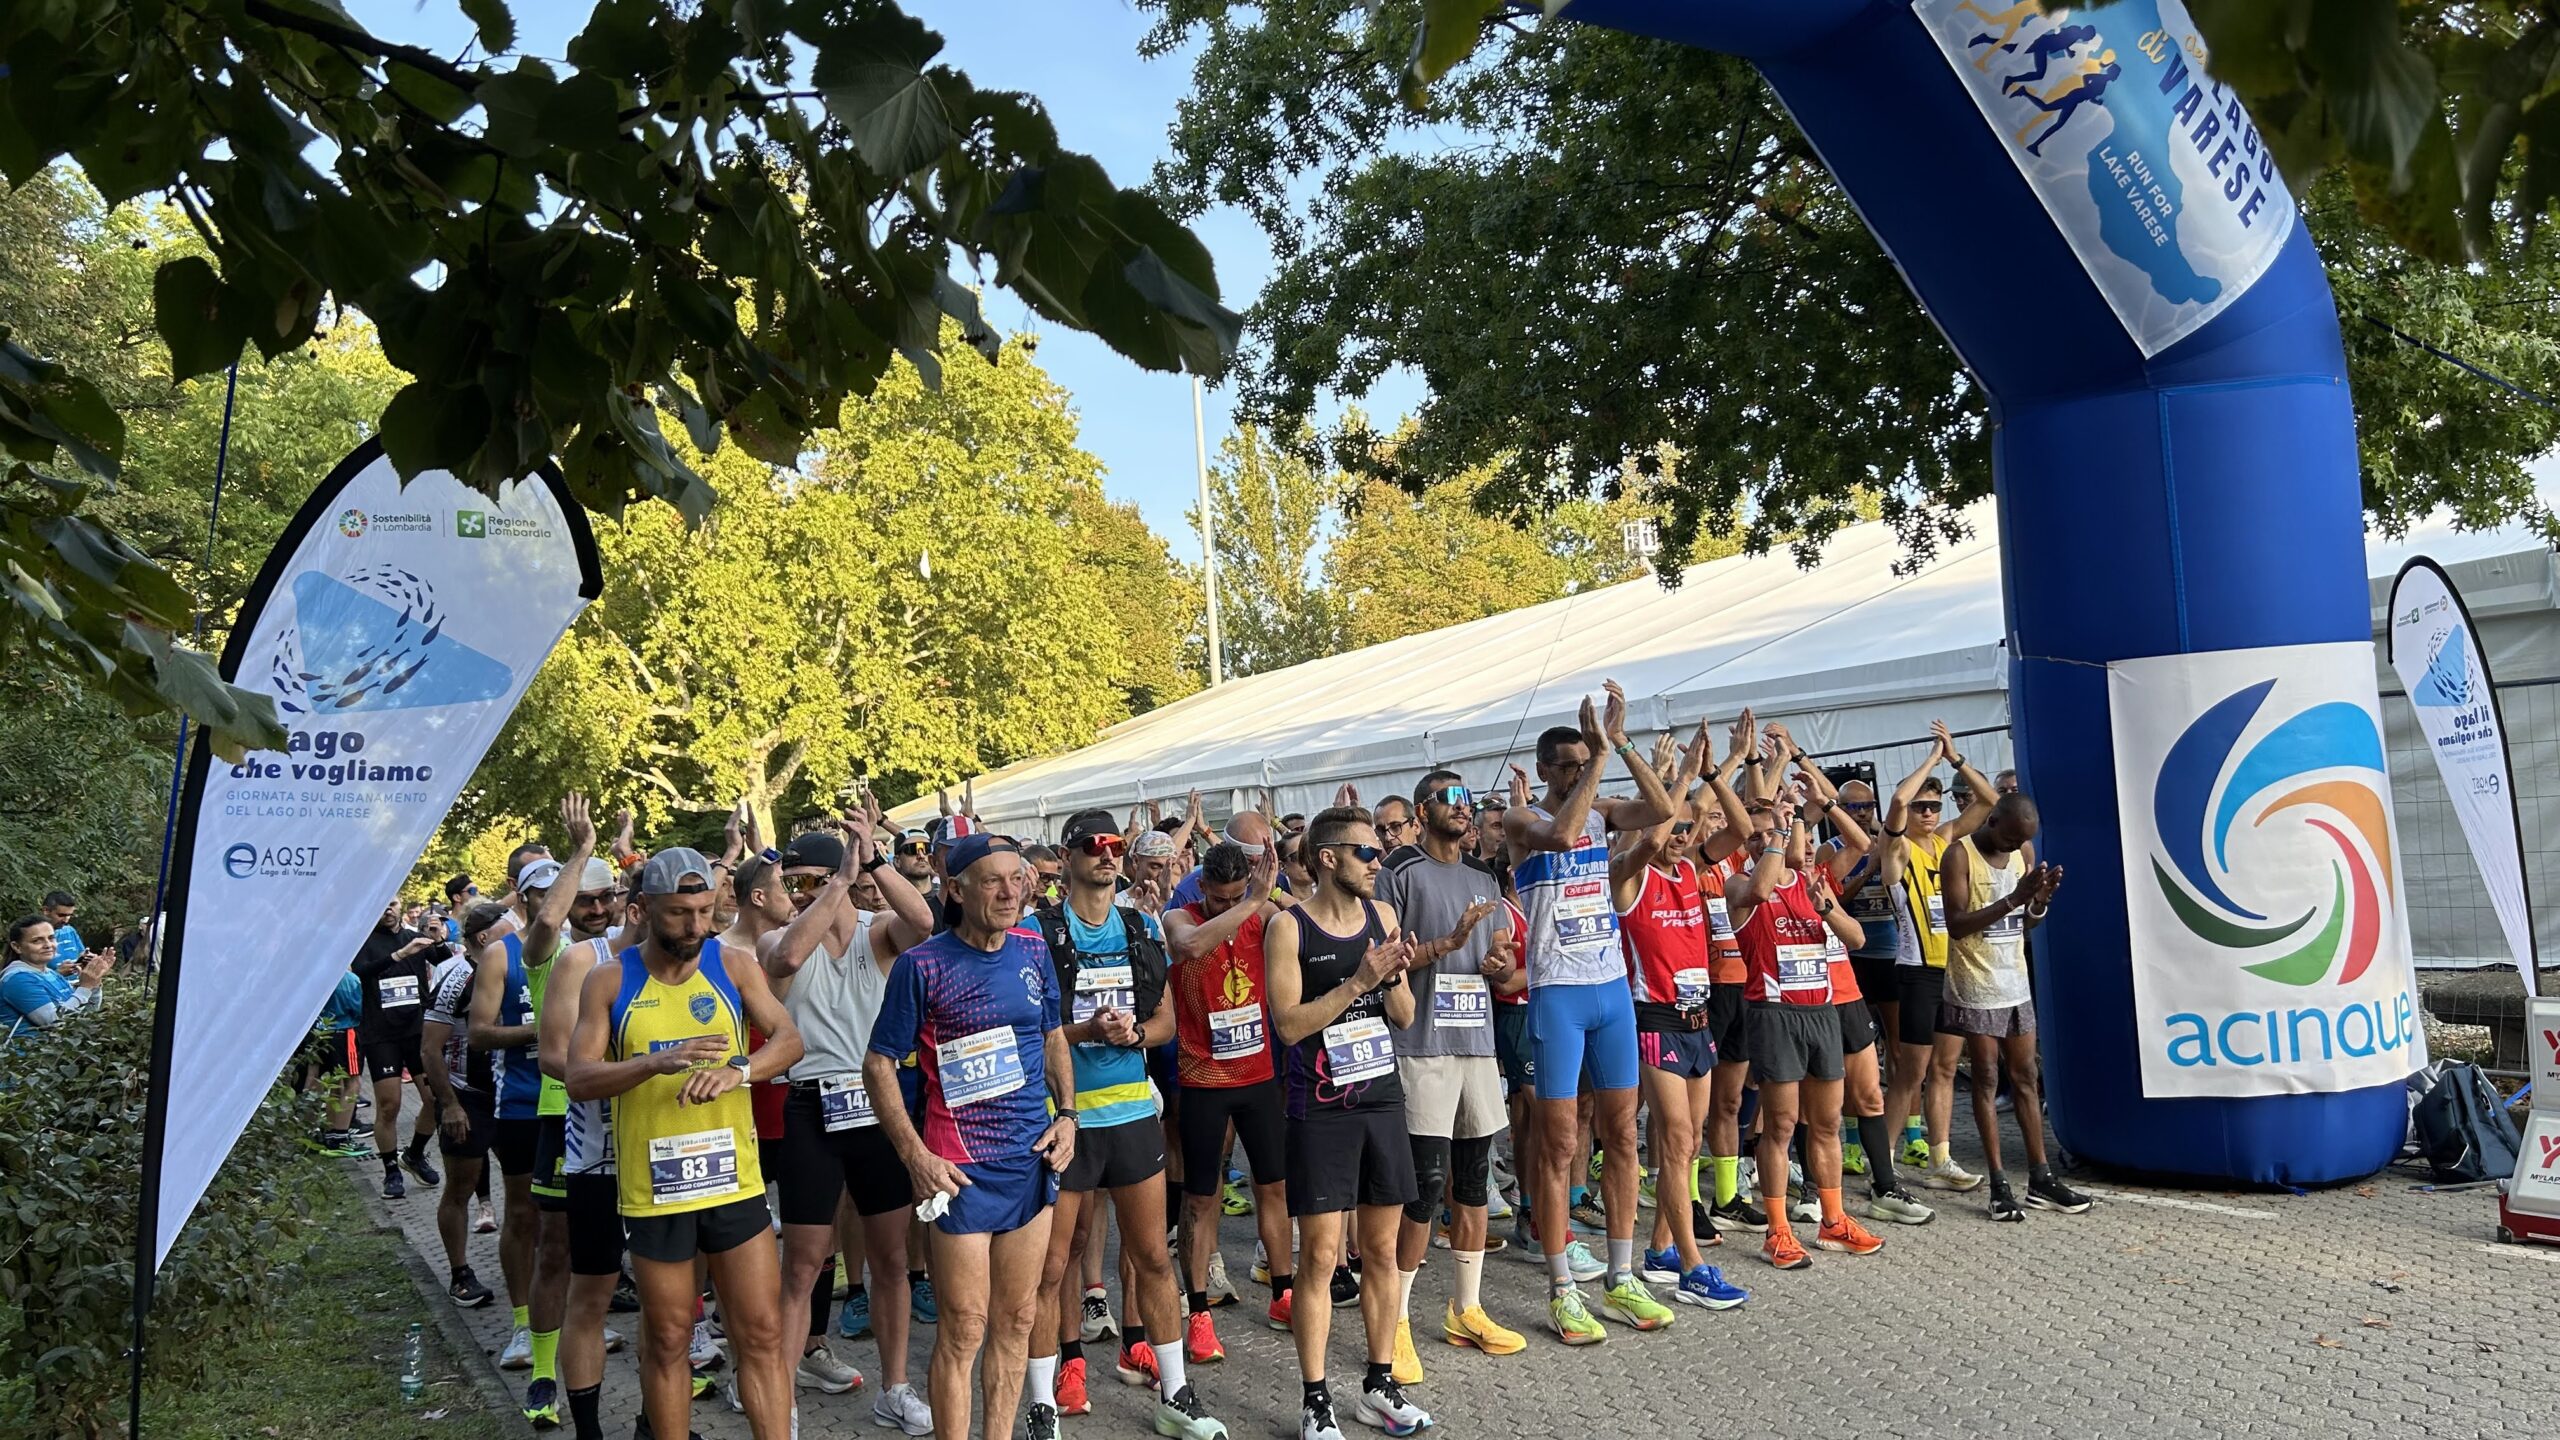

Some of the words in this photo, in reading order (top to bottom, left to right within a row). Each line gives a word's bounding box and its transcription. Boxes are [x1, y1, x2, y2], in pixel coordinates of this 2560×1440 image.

[2137, 29, 2169, 64] di
[2158, 53, 2266, 229] VARESE
[2127, 151, 2153, 186] RUN
[2148, 184, 2173, 218] FOR
[2099, 146, 2131, 188] LAKE
[2127, 186, 2168, 247] VARESE
[372, 514, 432, 523] Sostenibilità
[372, 524, 383, 532] in
[383, 523, 432, 532] Lombardia
[488, 516, 537, 528] Regione
[488, 527, 552, 539] Lombardia
[291, 759, 433, 786] vogliamo
[226, 790, 295, 802] GIORNATA
[301, 792, 327, 803] SUL
[333, 792, 428, 803] RISANAMENTO
[226, 805, 251, 816] DEL
[257, 805, 295, 817] LAGO
[300, 807, 312, 818] DI
[318, 807, 371, 818] VARESE
[261, 847, 320, 867] AQST
[260, 868, 279, 878] Lago
[282, 868, 290, 876] di
[293, 868, 317, 877] Varese
[1868, 899, 1884, 910] 25
[1578, 916, 1597, 935] 28
[1794, 960, 1817, 976] 105
[1094, 988, 1118, 1008] 171
[1452, 993, 1477, 1011] 180
[1228, 1024, 1252, 1044] 146
[2165, 990, 2412, 1068] acinque
[1352, 1040, 1374, 1062] 69
[961, 1053, 998, 1082] 337
[948, 1089, 962, 1097] GIRO
[962, 1085, 978, 1093] LAGO
[983, 1078, 1001, 1088] PASSO
[843, 1090, 871, 1111] 147
[681, 1156, 709, 1181] 83
[676, 1183, 693, 1191] LAGO
[693, 1176, 731, 1188] COMPETITIVO
[1687, 1280, 1709, 1295] HOKA
